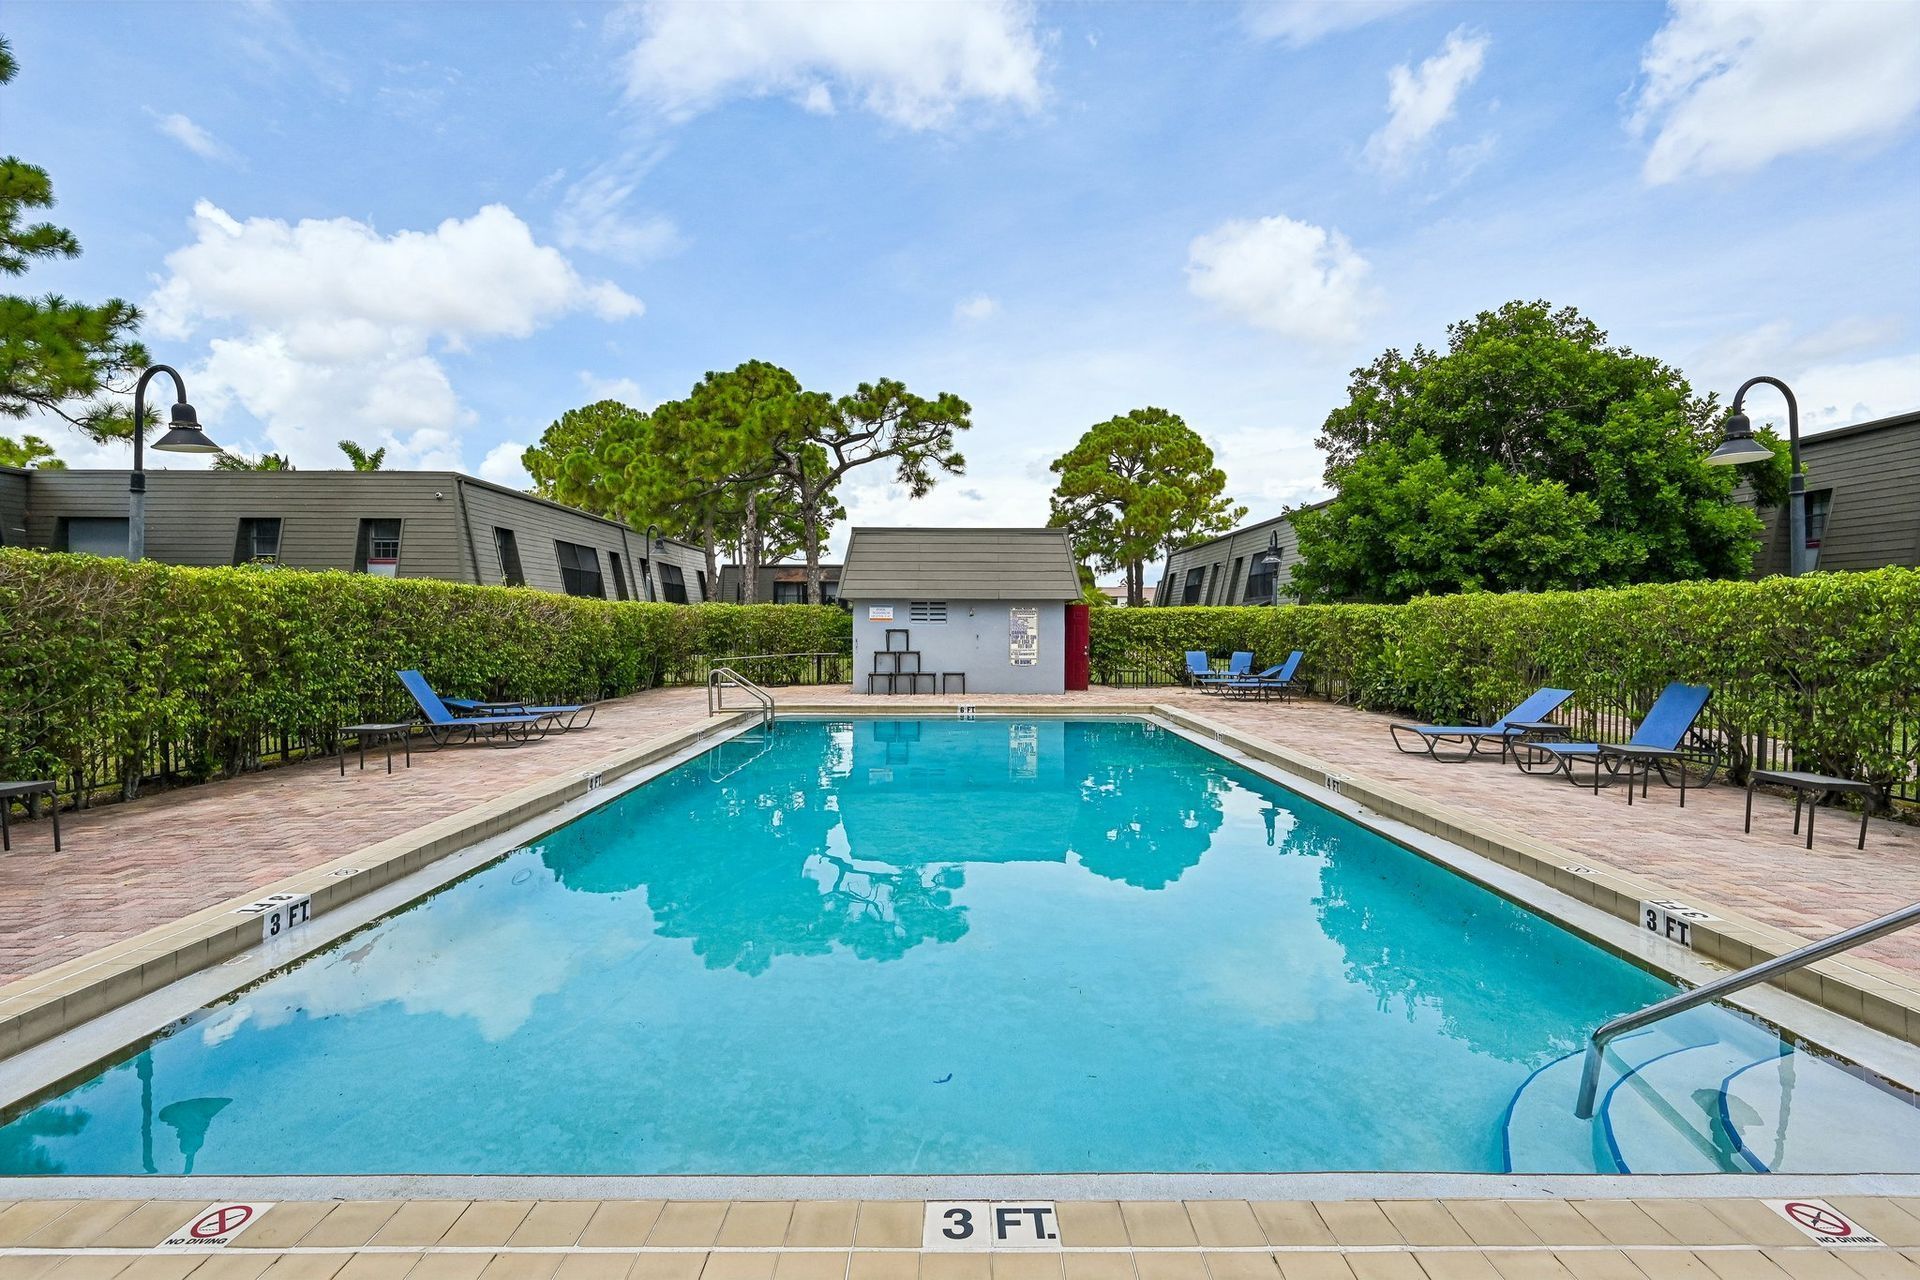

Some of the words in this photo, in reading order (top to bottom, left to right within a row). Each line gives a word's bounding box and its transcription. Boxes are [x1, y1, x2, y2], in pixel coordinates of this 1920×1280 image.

[270, 913, 281, 936] 3
[288, 899, 310, 928] FT.
[1646, 909, 1657, 932] 3
[1666, 915, 1691, 947] FT.
[942, 1208, 974, 1240] 3
[996, 1208, 1057, 1239] FT.
